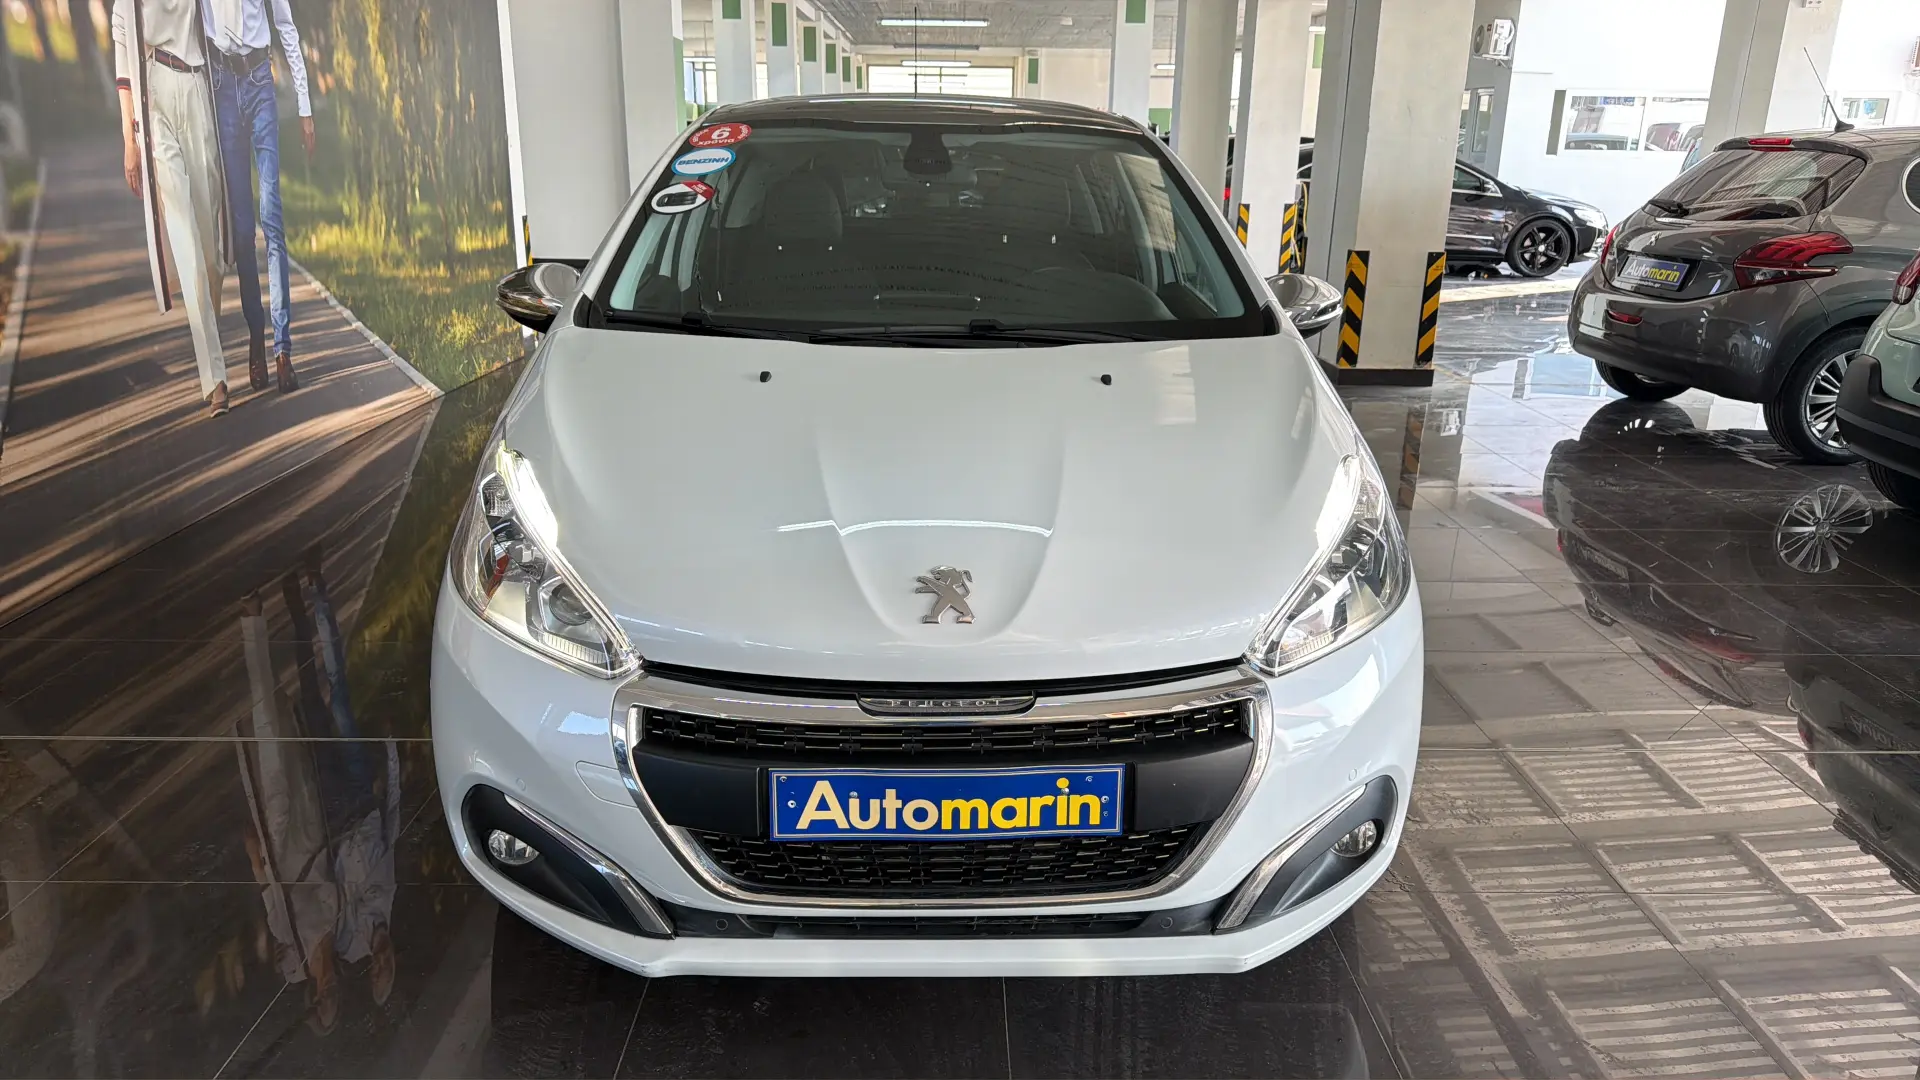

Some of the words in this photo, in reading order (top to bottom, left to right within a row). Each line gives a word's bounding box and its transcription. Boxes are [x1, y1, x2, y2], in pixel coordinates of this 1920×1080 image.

[711, 127, 731, 140] 6
[1625, 260, 1680, 283] Automarin
[891, 699, 1001, 708] PEUGEOT
[795, 777, 1101, 831] Automarin
